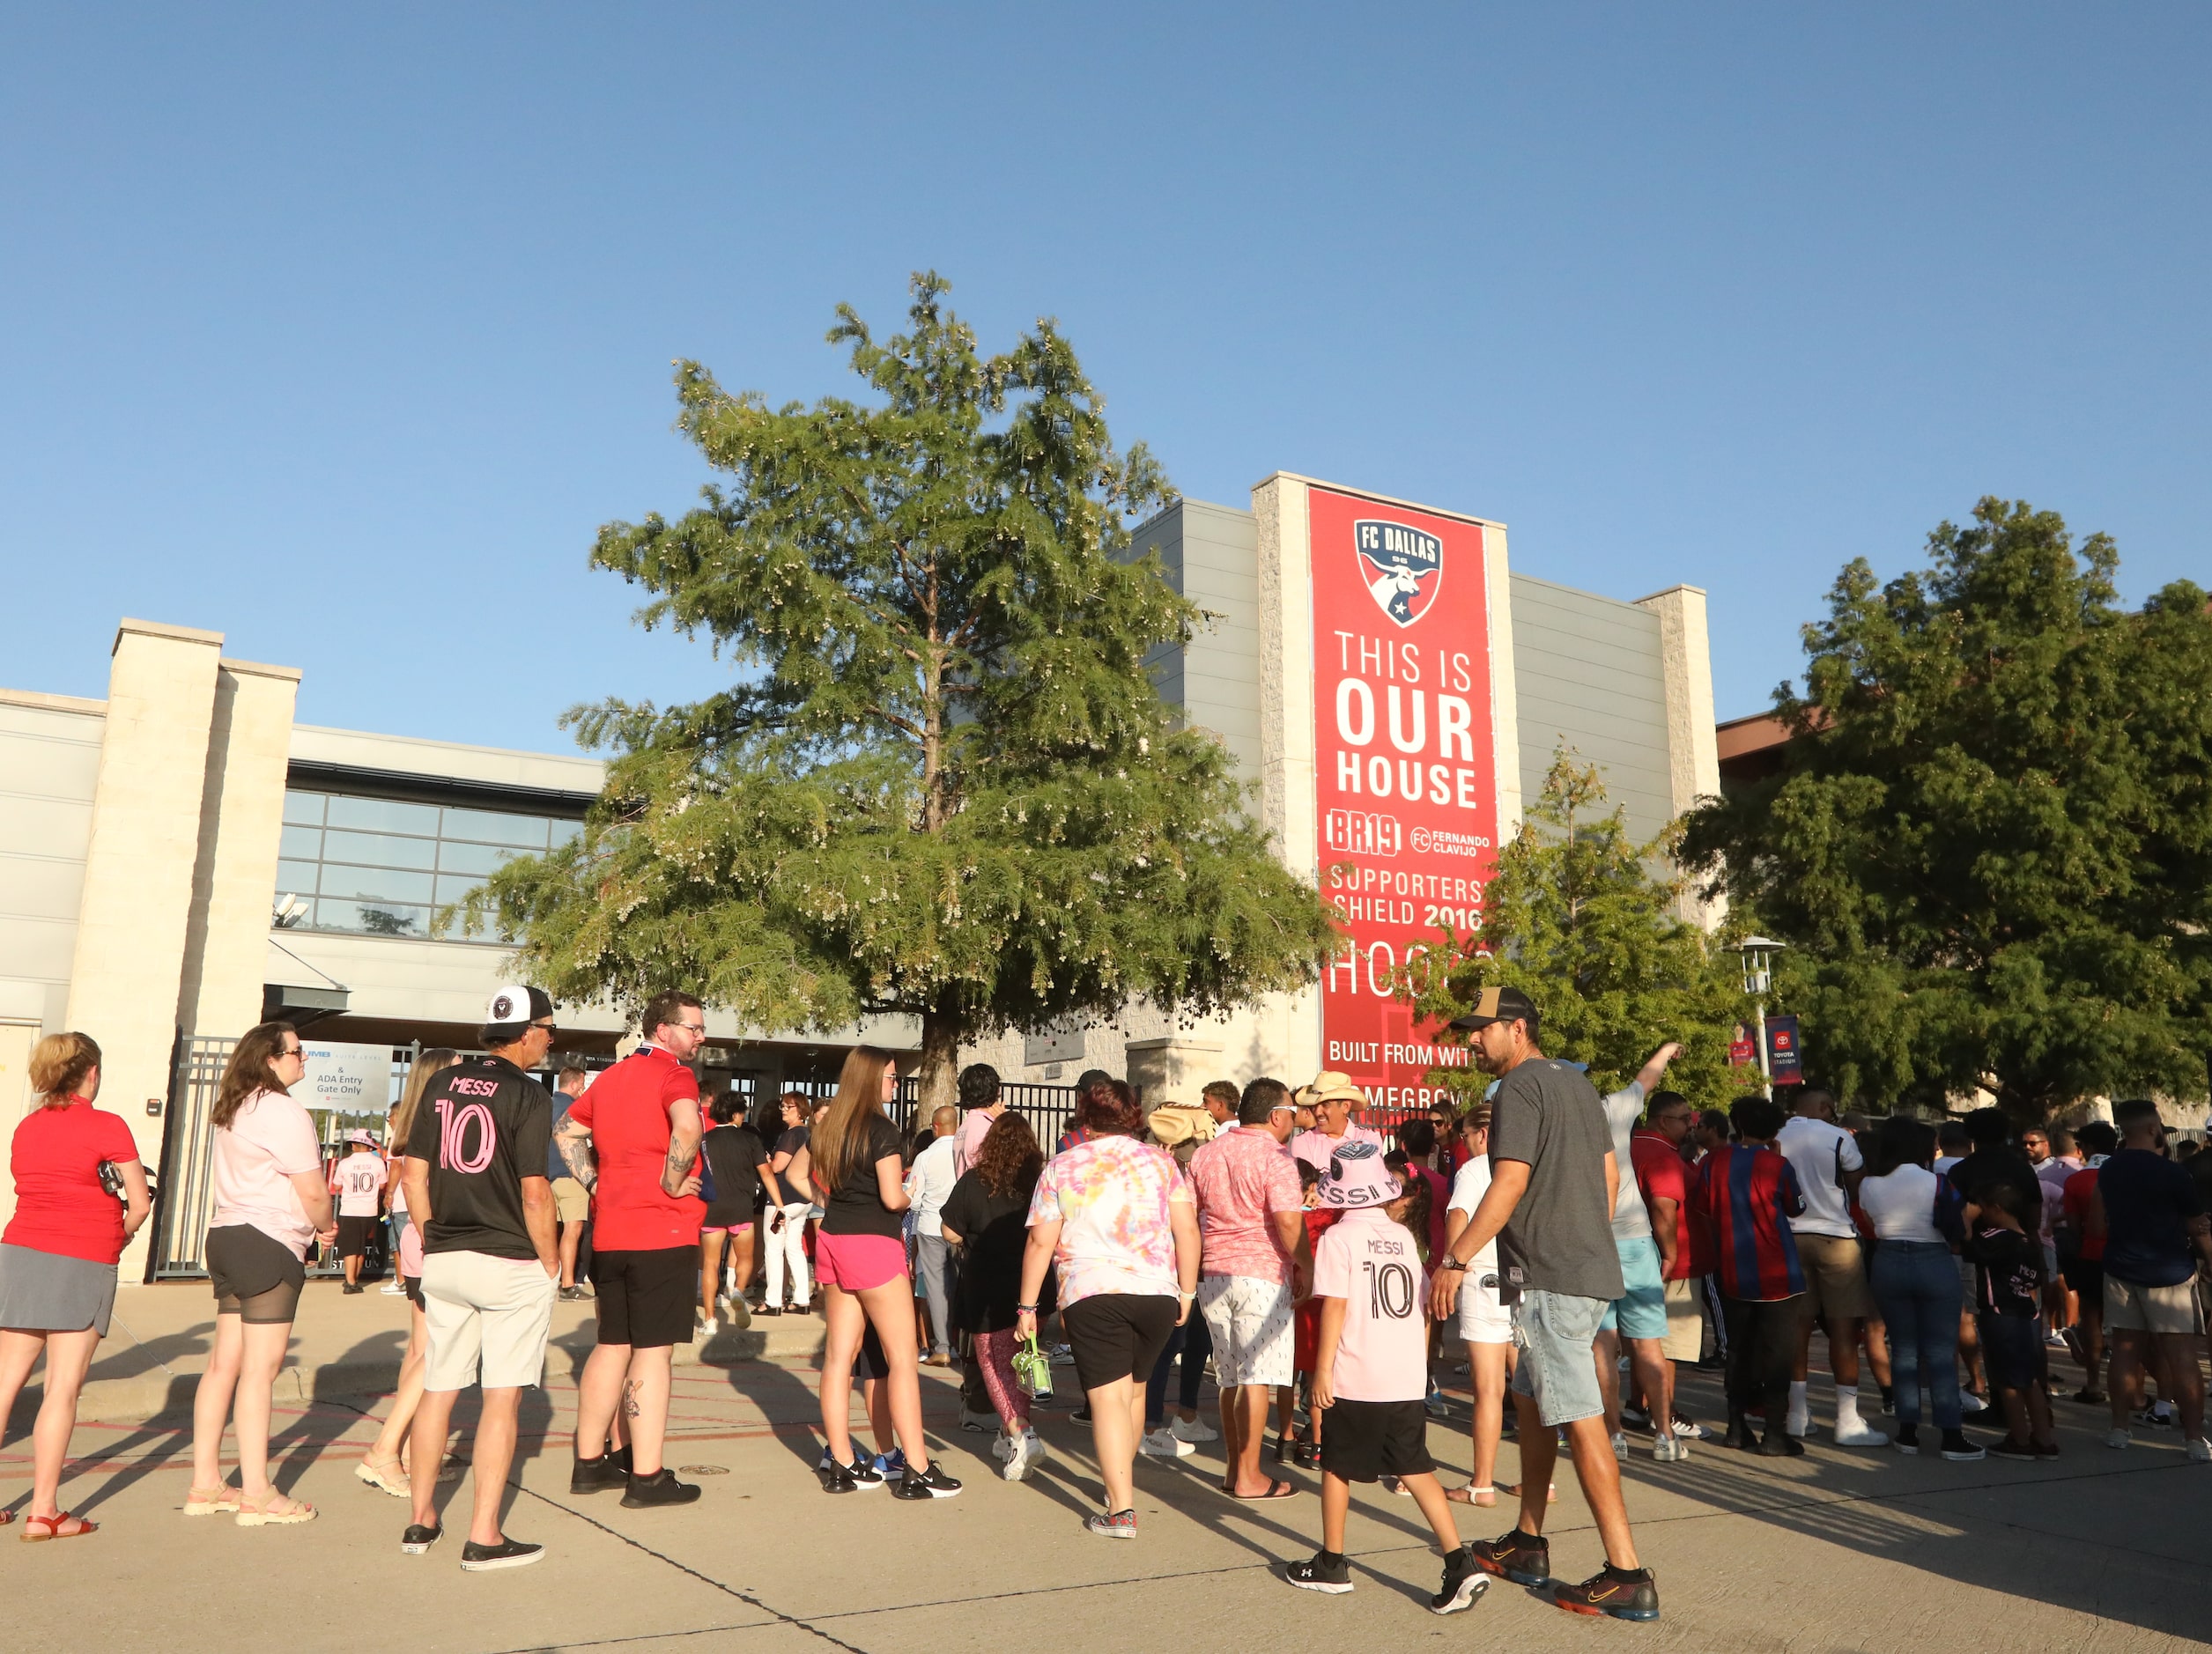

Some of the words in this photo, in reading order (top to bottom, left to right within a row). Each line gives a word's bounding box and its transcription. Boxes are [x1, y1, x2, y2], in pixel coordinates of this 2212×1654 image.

[1362, 526, 1380, 550] FC
[1385, 527, 1436, 563] DALLAS
[1334, 630, 1420, 683] THIS
[1439, 650, 1472, 692] IS
[1335, 677, 1474, 763] OUR
[1337, 750, 1476, 809] HOUSE
[1326, 808, 1402, 857] BR19
[1413, 832, 1430, 847] FC
[1432, 831, 1490, 847] FERNANDO
[1433, 843, 1477, 858] CLAVIJO
[1334, 895, 1414, 925] SHIELD
[1424, 905, 1483, 932] 2016
[1329, 1040, 1379, 1063] BUILT
[1384, 1043, 1432, 1066] FROM
[1438, 1045, 1476, 1067] WIT
[317, 1084, 338, 1093] Gate
[340, 1085, 361, 1096] Only
[339, 1075, 363, 1085] Entry
[448, 1076, 499, 1097] MESSI
[434, 1099, 497, 1174] 10
[351, 1172, 374, 1193] 10
[1316, 1180, 1381, 1206] ESSI
[1367, 1239, 1404, 1256] MESSI
[1363, 1261, 1414, 1319] 10
